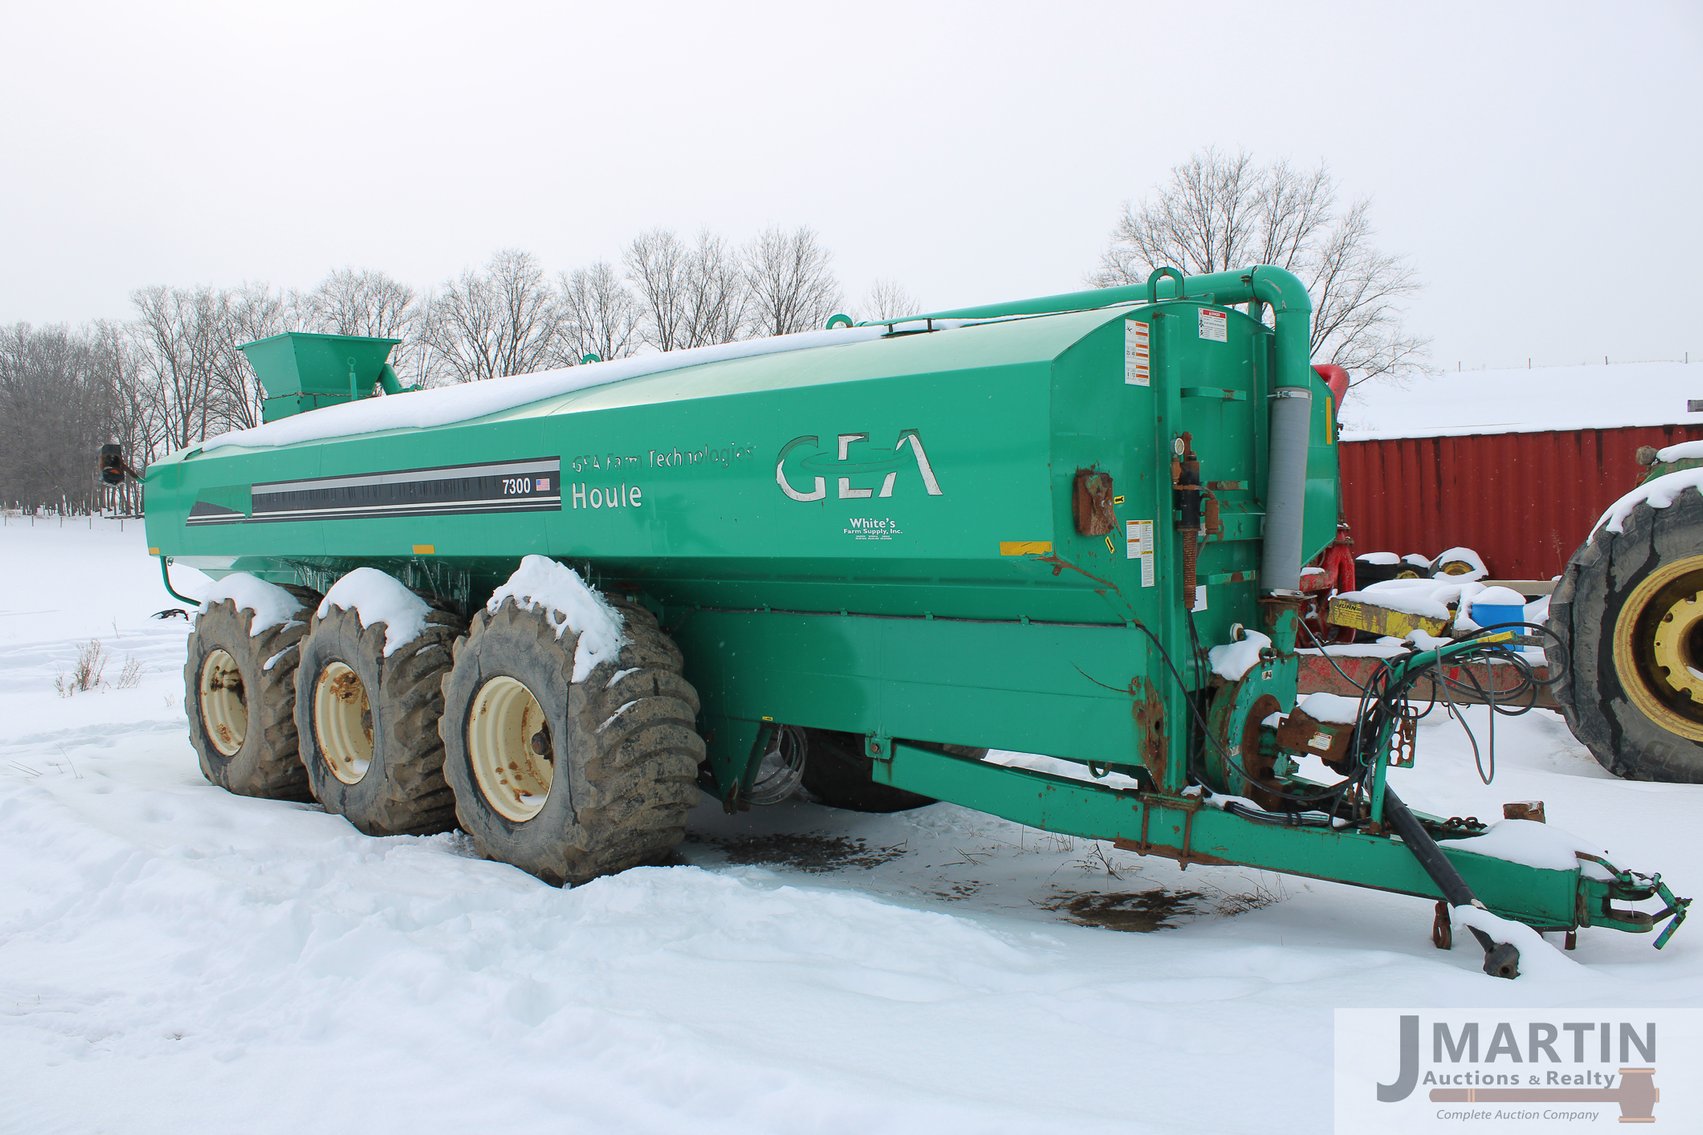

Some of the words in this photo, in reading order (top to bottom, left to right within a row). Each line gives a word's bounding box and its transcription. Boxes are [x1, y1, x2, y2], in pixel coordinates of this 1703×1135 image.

[502, 477, 531, 495] 7300
[572, 482, 642, 509] Houle
[849, 517, 896, 528] White's
